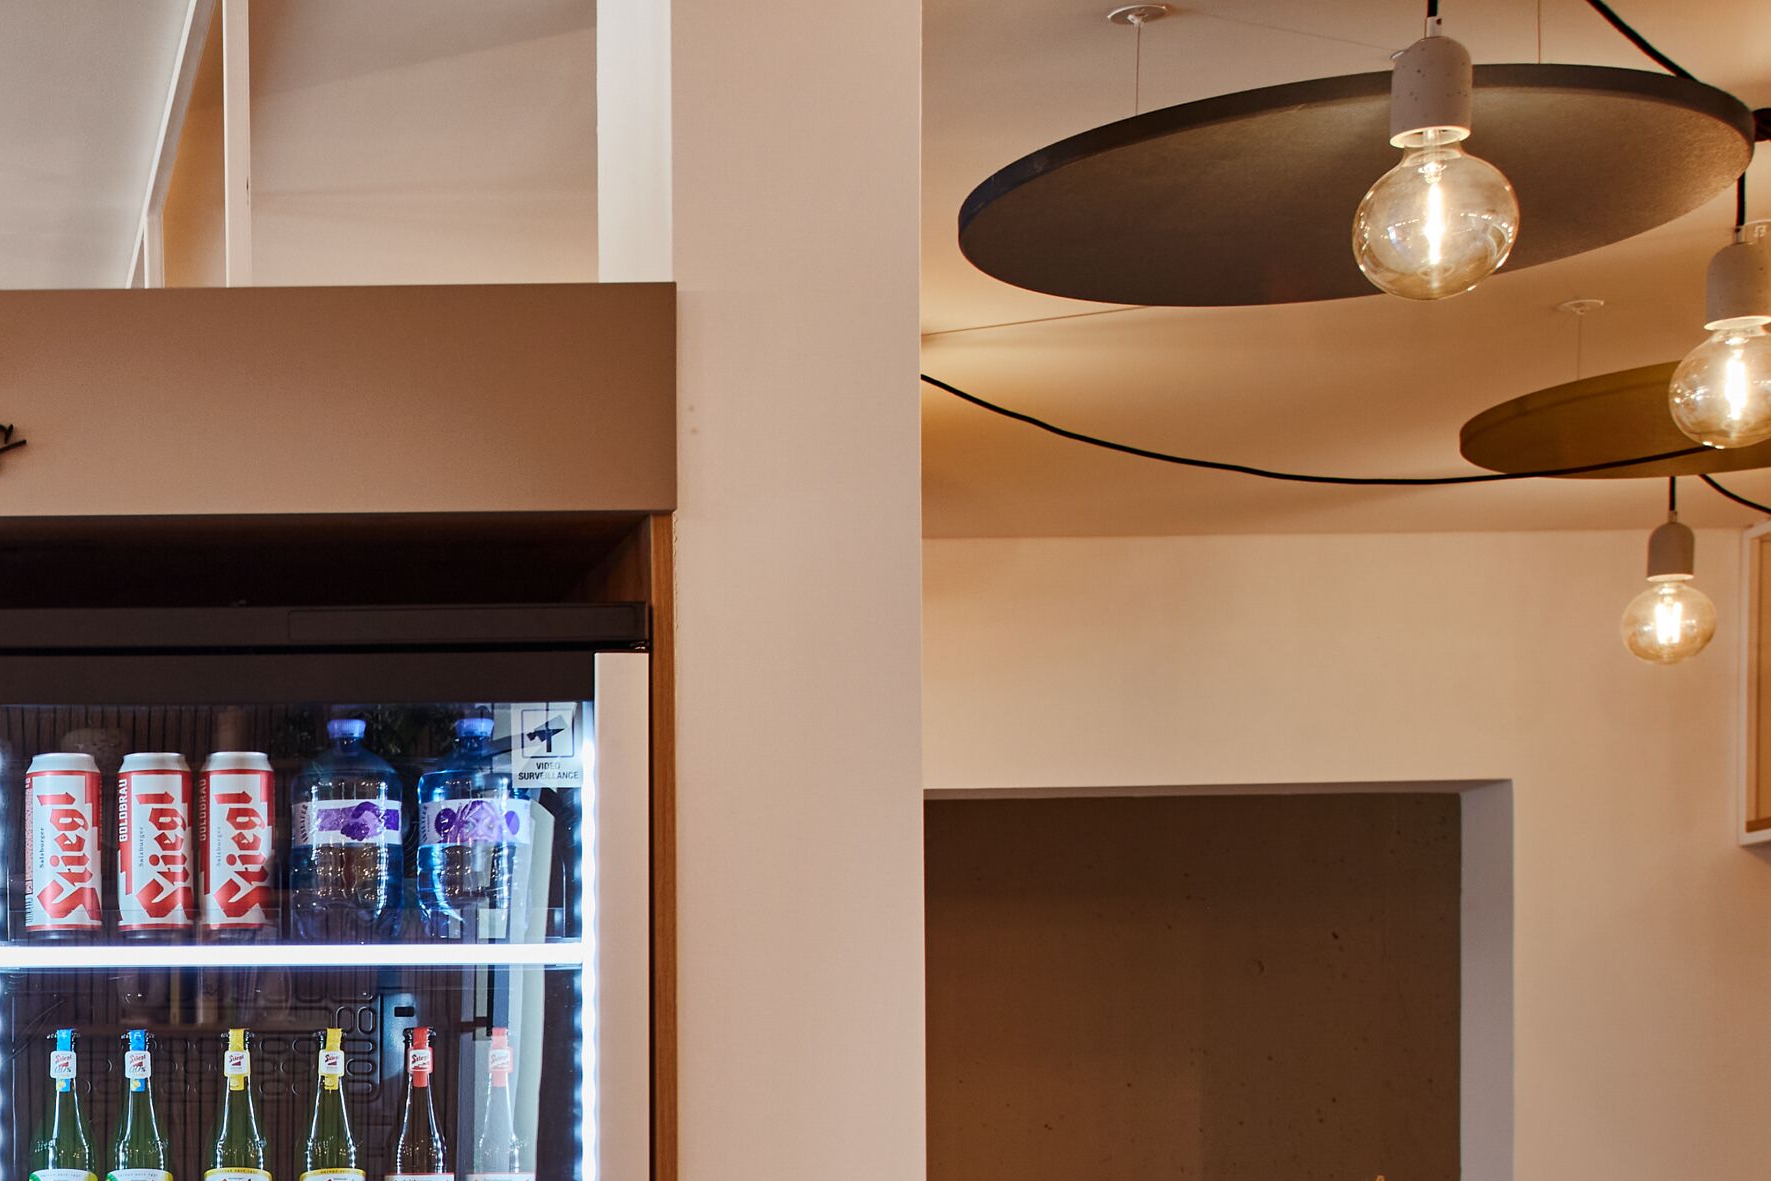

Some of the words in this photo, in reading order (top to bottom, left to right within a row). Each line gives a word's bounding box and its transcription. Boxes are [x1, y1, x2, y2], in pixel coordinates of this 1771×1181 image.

[517, 771, 579, 781] SURVEILLANCE
[535, 762, 561, 770] VIDEO
[37, 792, 102, 920] Stiegl
[135, 791, 194, 920] Stiegl
[213, 791, 270, 920] Stiegl
